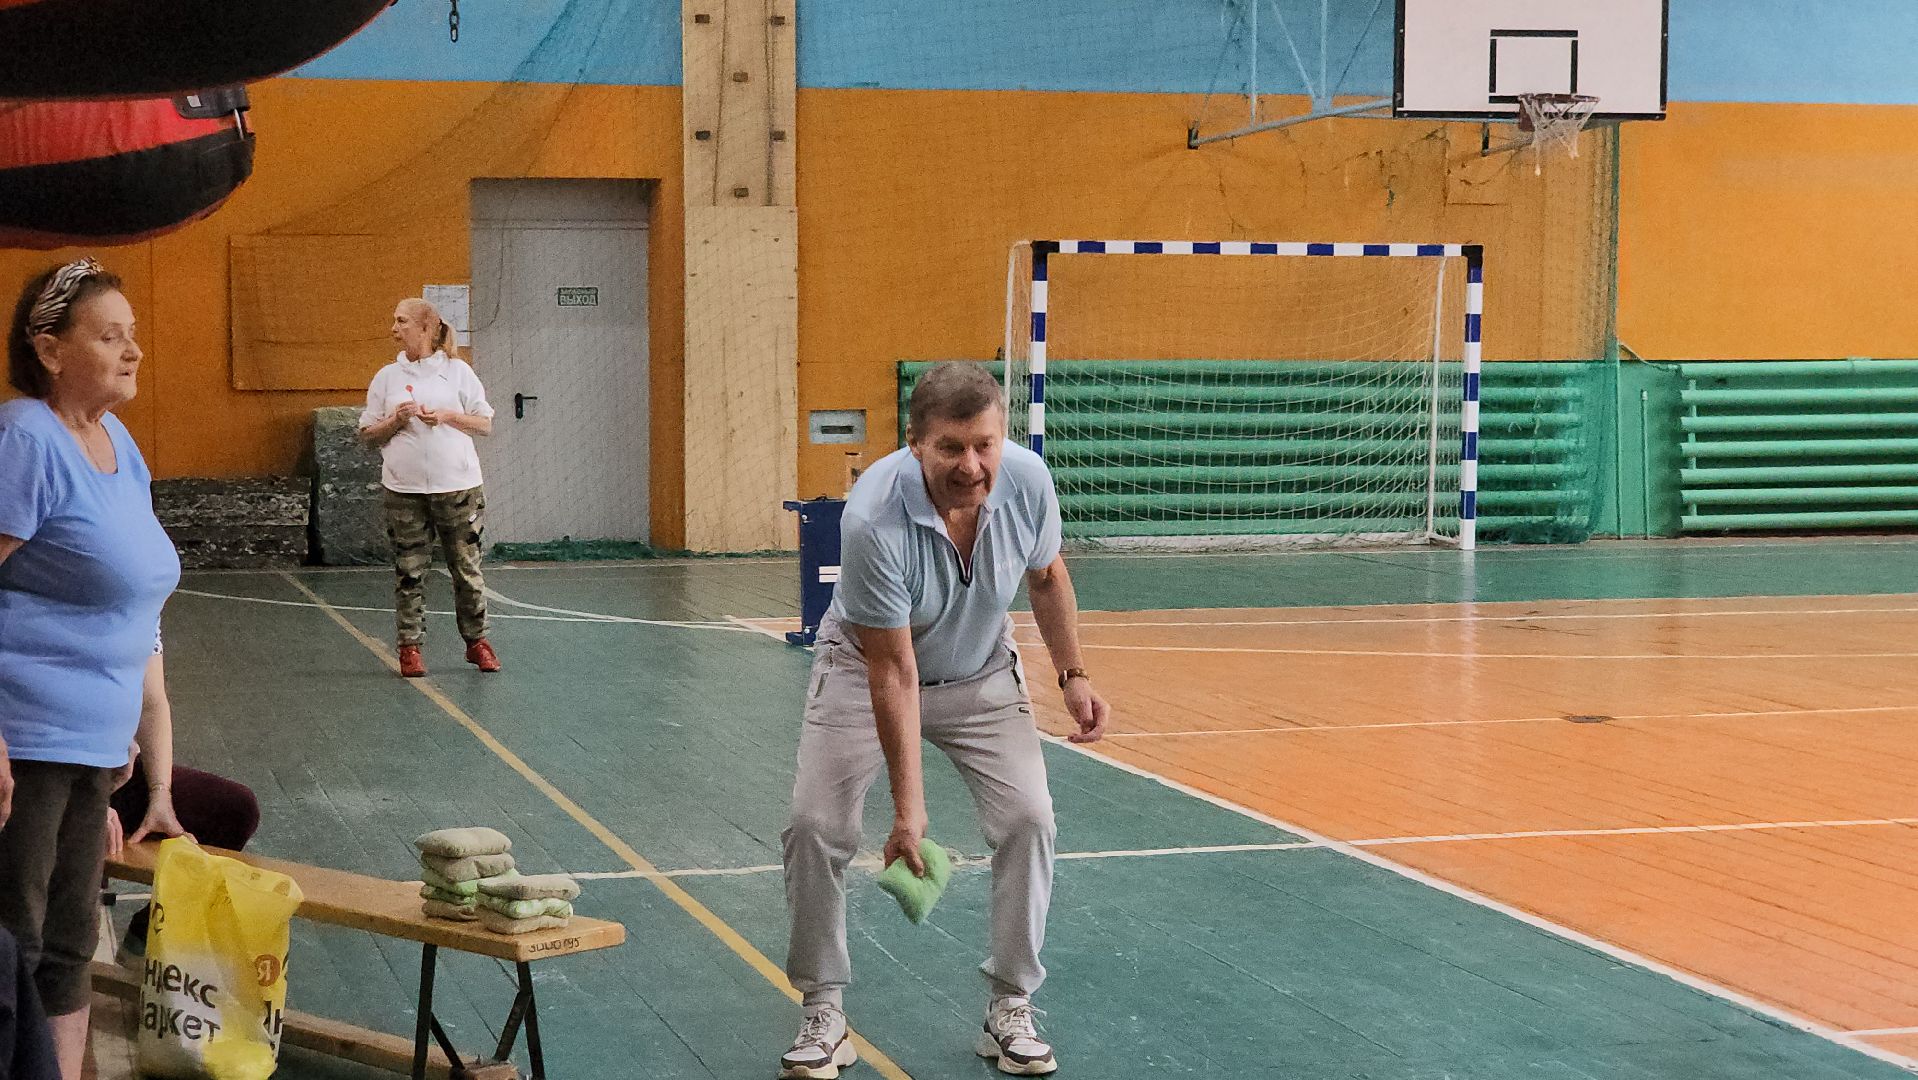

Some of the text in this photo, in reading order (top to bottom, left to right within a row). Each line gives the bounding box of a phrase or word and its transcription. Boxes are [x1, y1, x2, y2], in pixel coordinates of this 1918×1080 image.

[560, 295, 596, 305] ВЫХОД
[145, 959, 218, 1009] некс
[141, 991, 221, 1042] аркет
